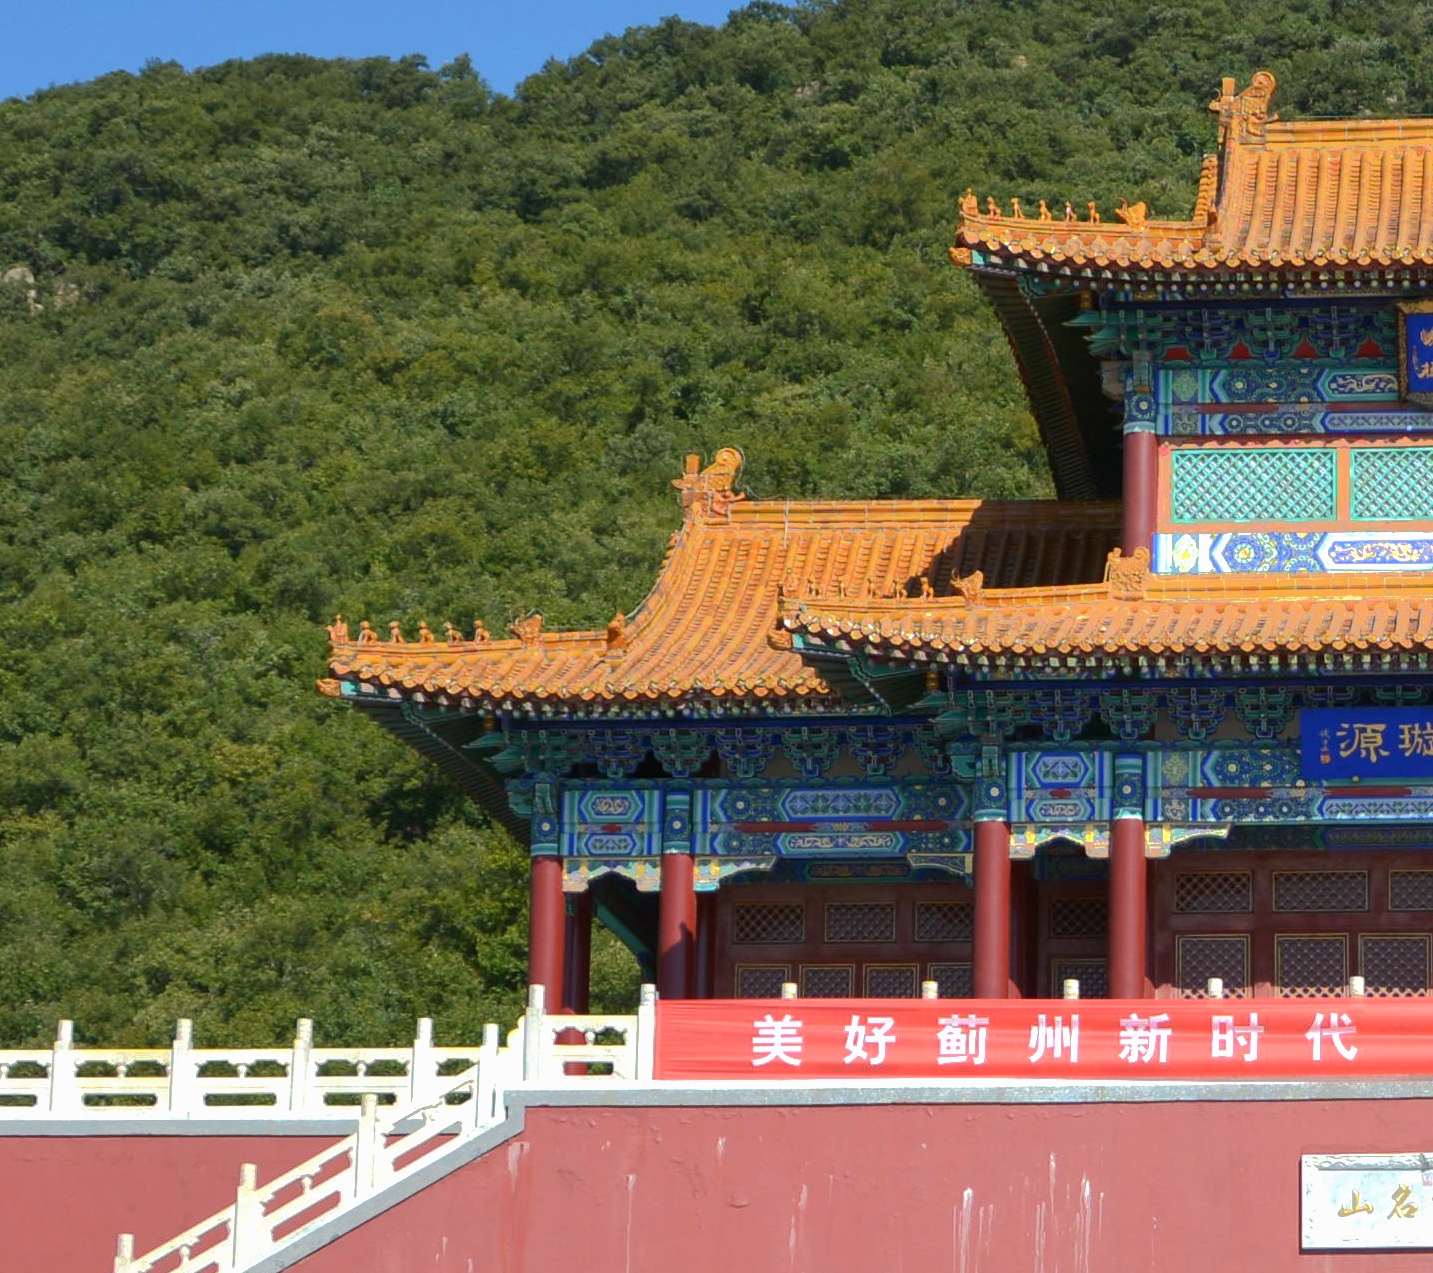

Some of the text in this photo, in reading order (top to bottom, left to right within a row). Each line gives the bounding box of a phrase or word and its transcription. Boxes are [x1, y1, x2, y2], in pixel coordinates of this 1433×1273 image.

[751, 1012, 1359, 1067] 美好蓟州新时代
